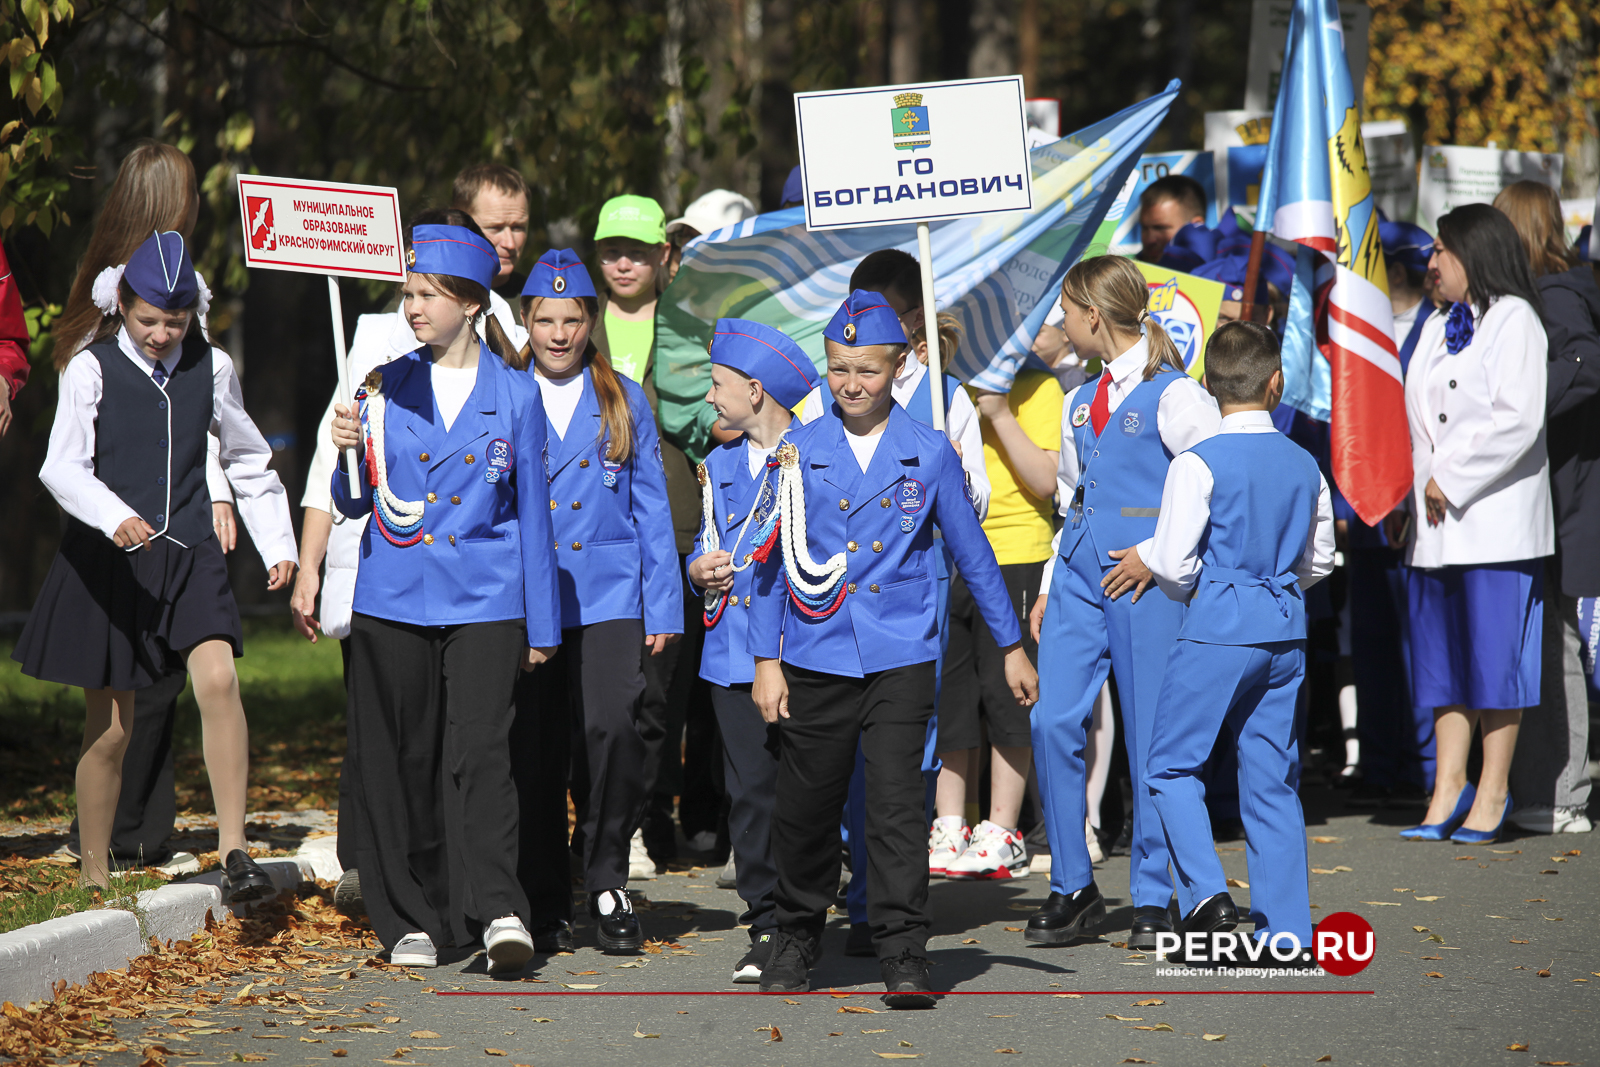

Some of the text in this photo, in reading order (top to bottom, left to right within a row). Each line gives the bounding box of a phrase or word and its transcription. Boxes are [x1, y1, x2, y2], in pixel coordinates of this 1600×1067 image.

[897, 158, 934, 177] ГО
[1142, 162, 1170, 182] ГО
[814, 174, 1023, 207] БОГДАНОВИЧ
[293, 200, 374, 218] МУНИЦИПАЛЬНОЕ
[303, 219, 367, 236] ОБРАЗОВАНИЕ
[279, 235, 394, 257] КРАСНОУФИМСКИЙ ОКРУГ
